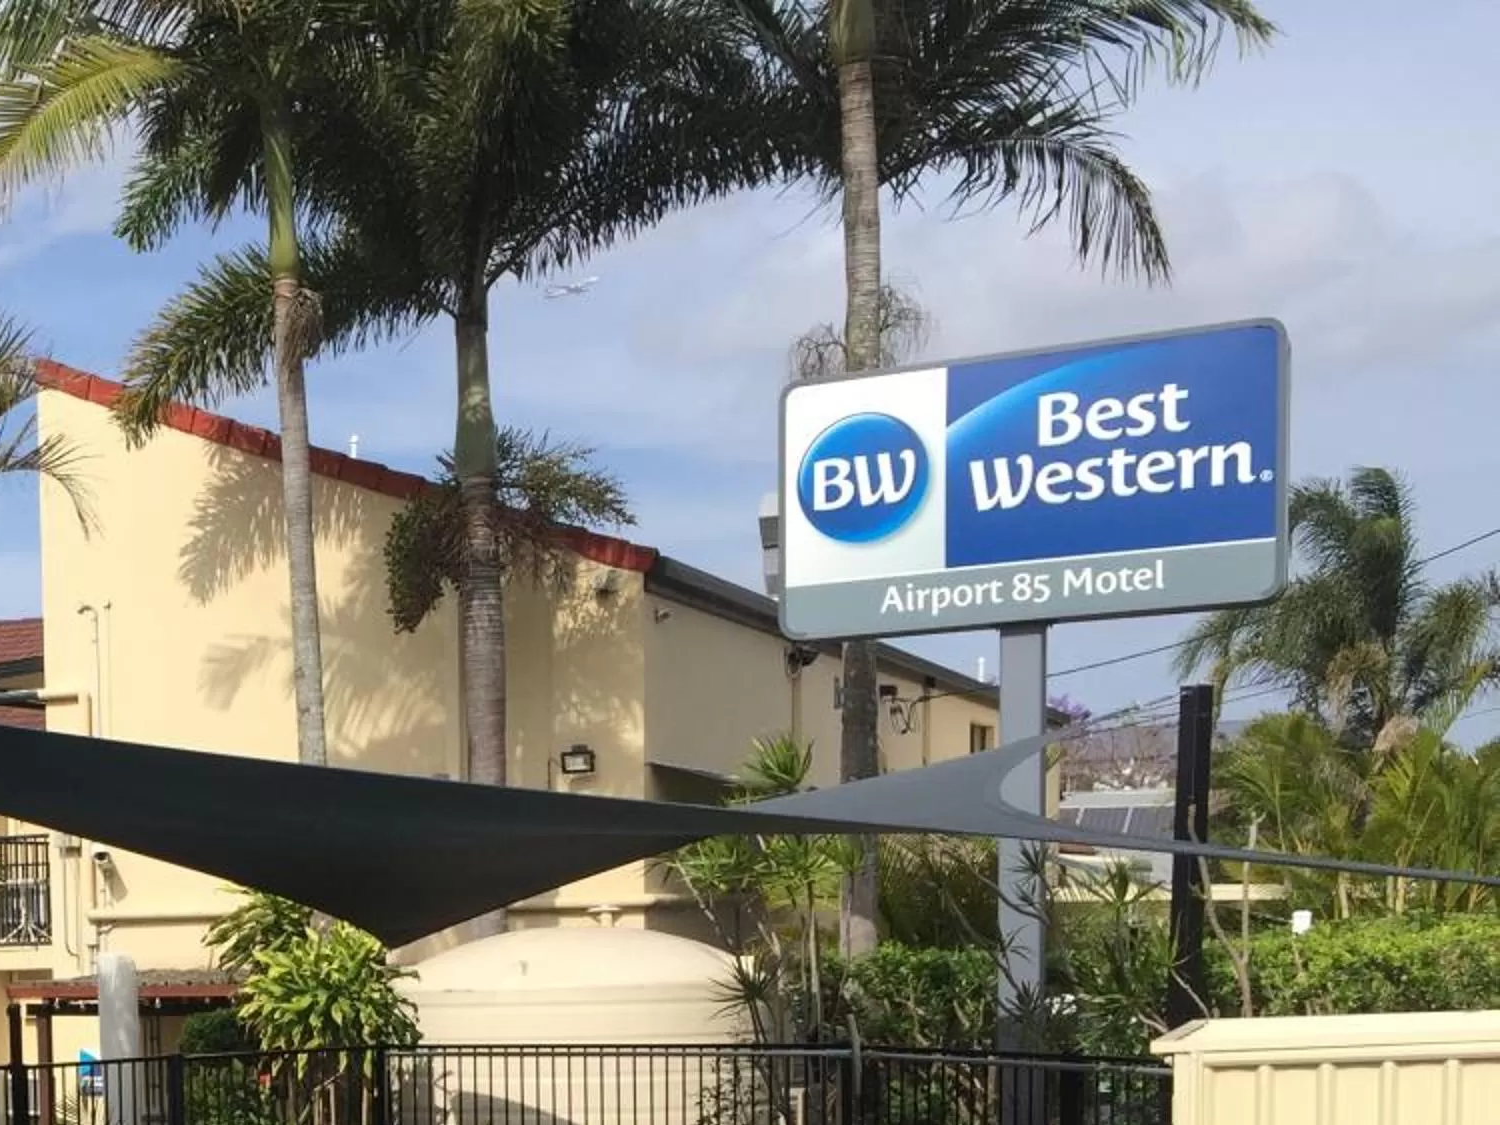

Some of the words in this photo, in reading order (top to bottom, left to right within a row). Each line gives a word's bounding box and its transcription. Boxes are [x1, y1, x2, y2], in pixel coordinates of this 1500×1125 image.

[1037, 383, 1190, 447] Best
[813, 449, 915, 511] BW
[970, 441, 1256, 511] Western
[880, 578, 1004, 616] Airport
[1011, 573, 1051, 603] 85
[1063, 559, 1164, 597] Motel
